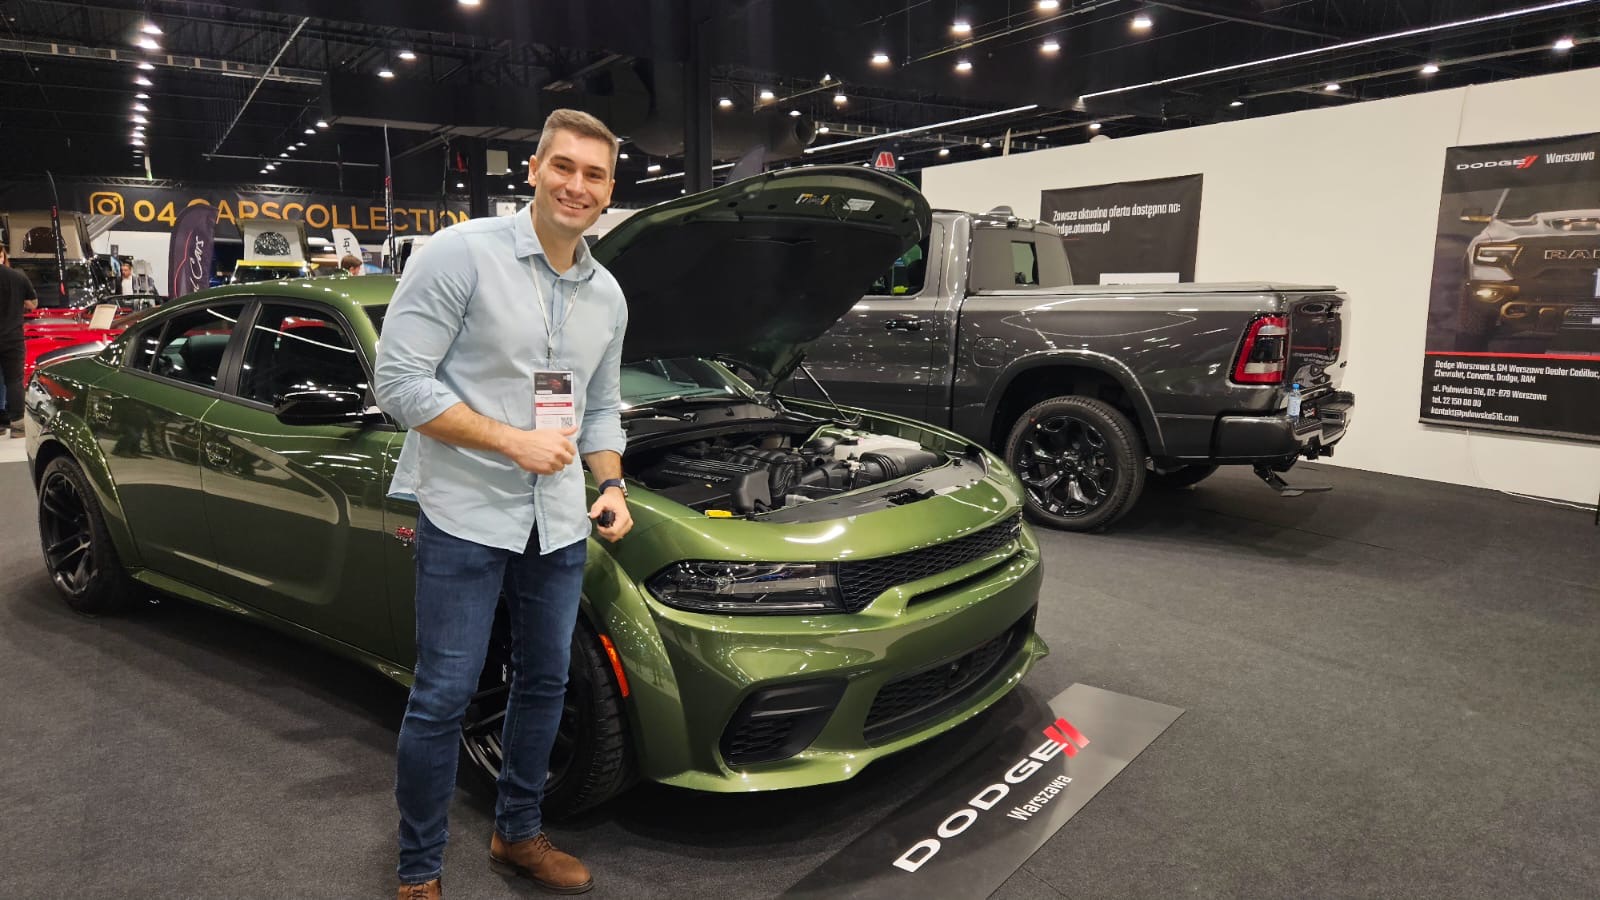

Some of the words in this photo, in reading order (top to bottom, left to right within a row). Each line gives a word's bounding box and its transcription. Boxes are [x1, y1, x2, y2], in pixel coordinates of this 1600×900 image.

[1456, 158, 1527, 170] DODGE
[1546, 151, 1595, 164] Warszawa
[186, 198, 471, 233] ARSCOLLECTIO
[1053, 210, 1078, 222] Zawsze
[1078, 206, 1108, 220] aktualna
[1109, 205, 1130, 218] oferta
[1131, 203, 1167, 219] dostępna
[1168, 203, 1181, 214] na:
[1544, 249, 1600, 260] RA
[1434, 369, 1466, 380] Chevrolet,
[1466, 371, 1495, 382] Corvette,
[1496, 373, 1520, 384] Dodge,
[1520, 375, 1536, 384] RAM
[1435, 360, 1455, 370] Dodge
[1456, 361, 1490, 371] Warszawa
[1490, 363, 1497, 372] &
[1508, 364, 1545, 375] Warszawa
[1545, 366, 1568, 376] Dealer
[1431, 396, 1442, 404] tel.
[1442, 396, 1451, 405] 22
[1512, 390, 1548, 401] Warszawa
[892, 738, 1069, 873] DODGE
[1006, 774, 1073, 822] Warszawa
